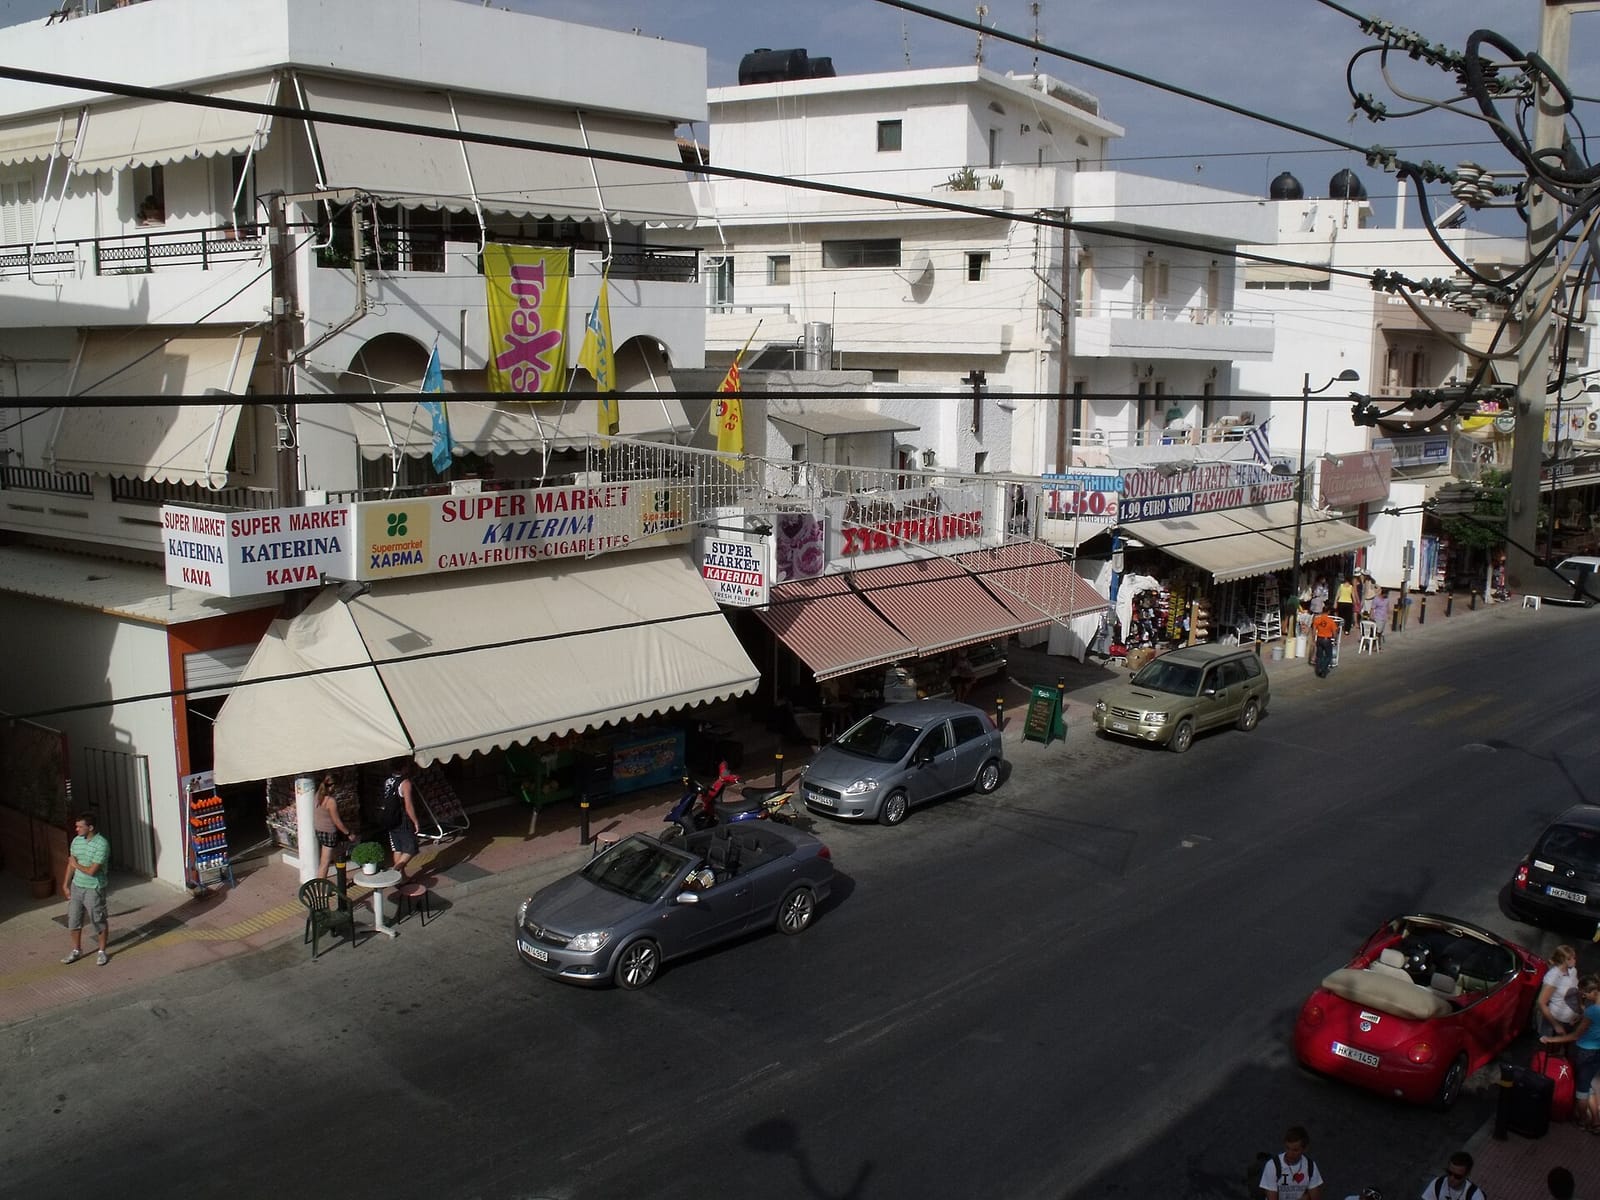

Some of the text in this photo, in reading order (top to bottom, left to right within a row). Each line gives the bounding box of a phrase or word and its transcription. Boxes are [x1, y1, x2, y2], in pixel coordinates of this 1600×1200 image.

[1123, 464, 1231, 498] SOUVENIR MARKET
[442, 487, 631, 523] SUPER MARKET
[1121, 502, 1140, 520] 1.99
[1168, 496, 1191, 513] SHOP
[1193, 481, 1294, 512] FASHION CLOTHES
[165, 511, 226, 538] SUPER MARKET
[231, 509, 349, 538] SUPER MARKET
[482, 514, 594, 545] KATERINA
[168, 538, 224, 564] KATERINA
[241, 536, 342, 564] KATERINA
[371, 541, 423, 555] Supermarket
[712, 541, 753, 559] SUPER
[266, 565, 319, 586] KAVA
[704, 554, 761, 573] MARKET
[183, 567, 212, 587] KAVA
[706, 568, 760, 585] KATERINA
[720, 582, 743, 595] KAVA
[714, 591, 733, 600] FRESH
[734, 594, 751, 603] FRUIT
